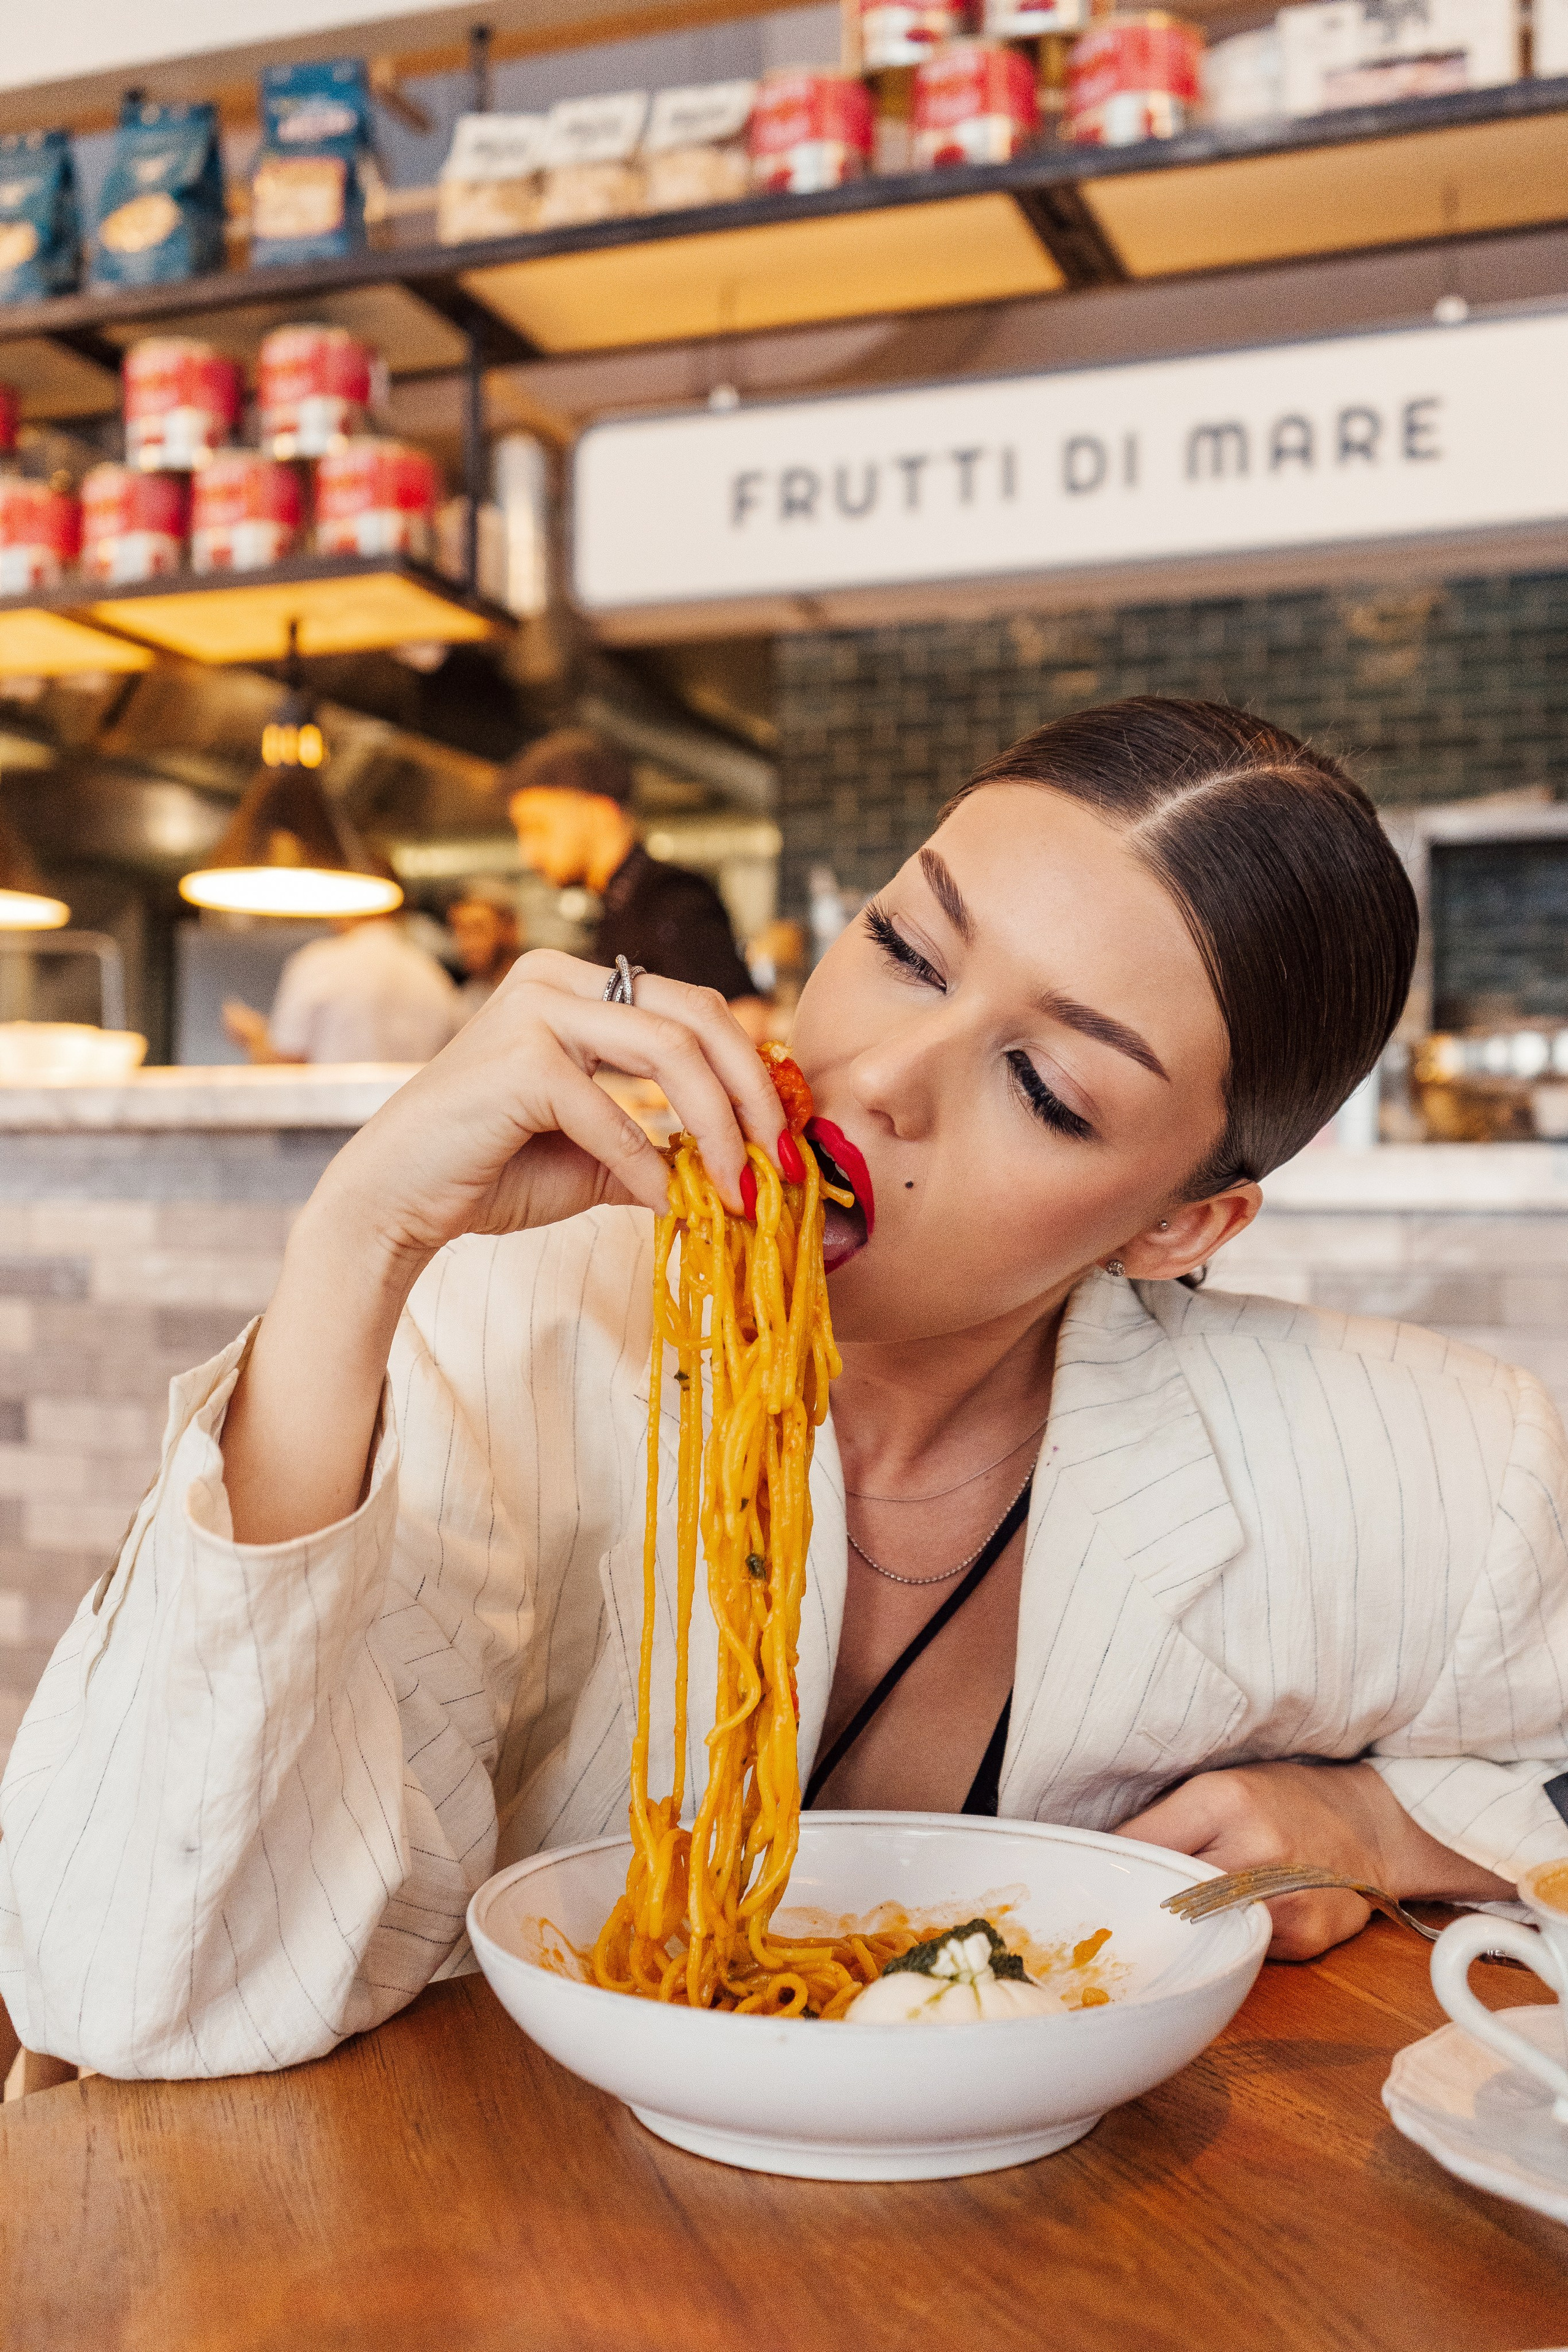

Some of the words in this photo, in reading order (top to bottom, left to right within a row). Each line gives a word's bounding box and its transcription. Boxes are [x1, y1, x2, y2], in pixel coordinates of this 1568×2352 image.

[730, 446, 1017, 529] FRUTTI
[1062, 431, 1140, 497] DI
[1185, 396, 1443, 481] MARE
